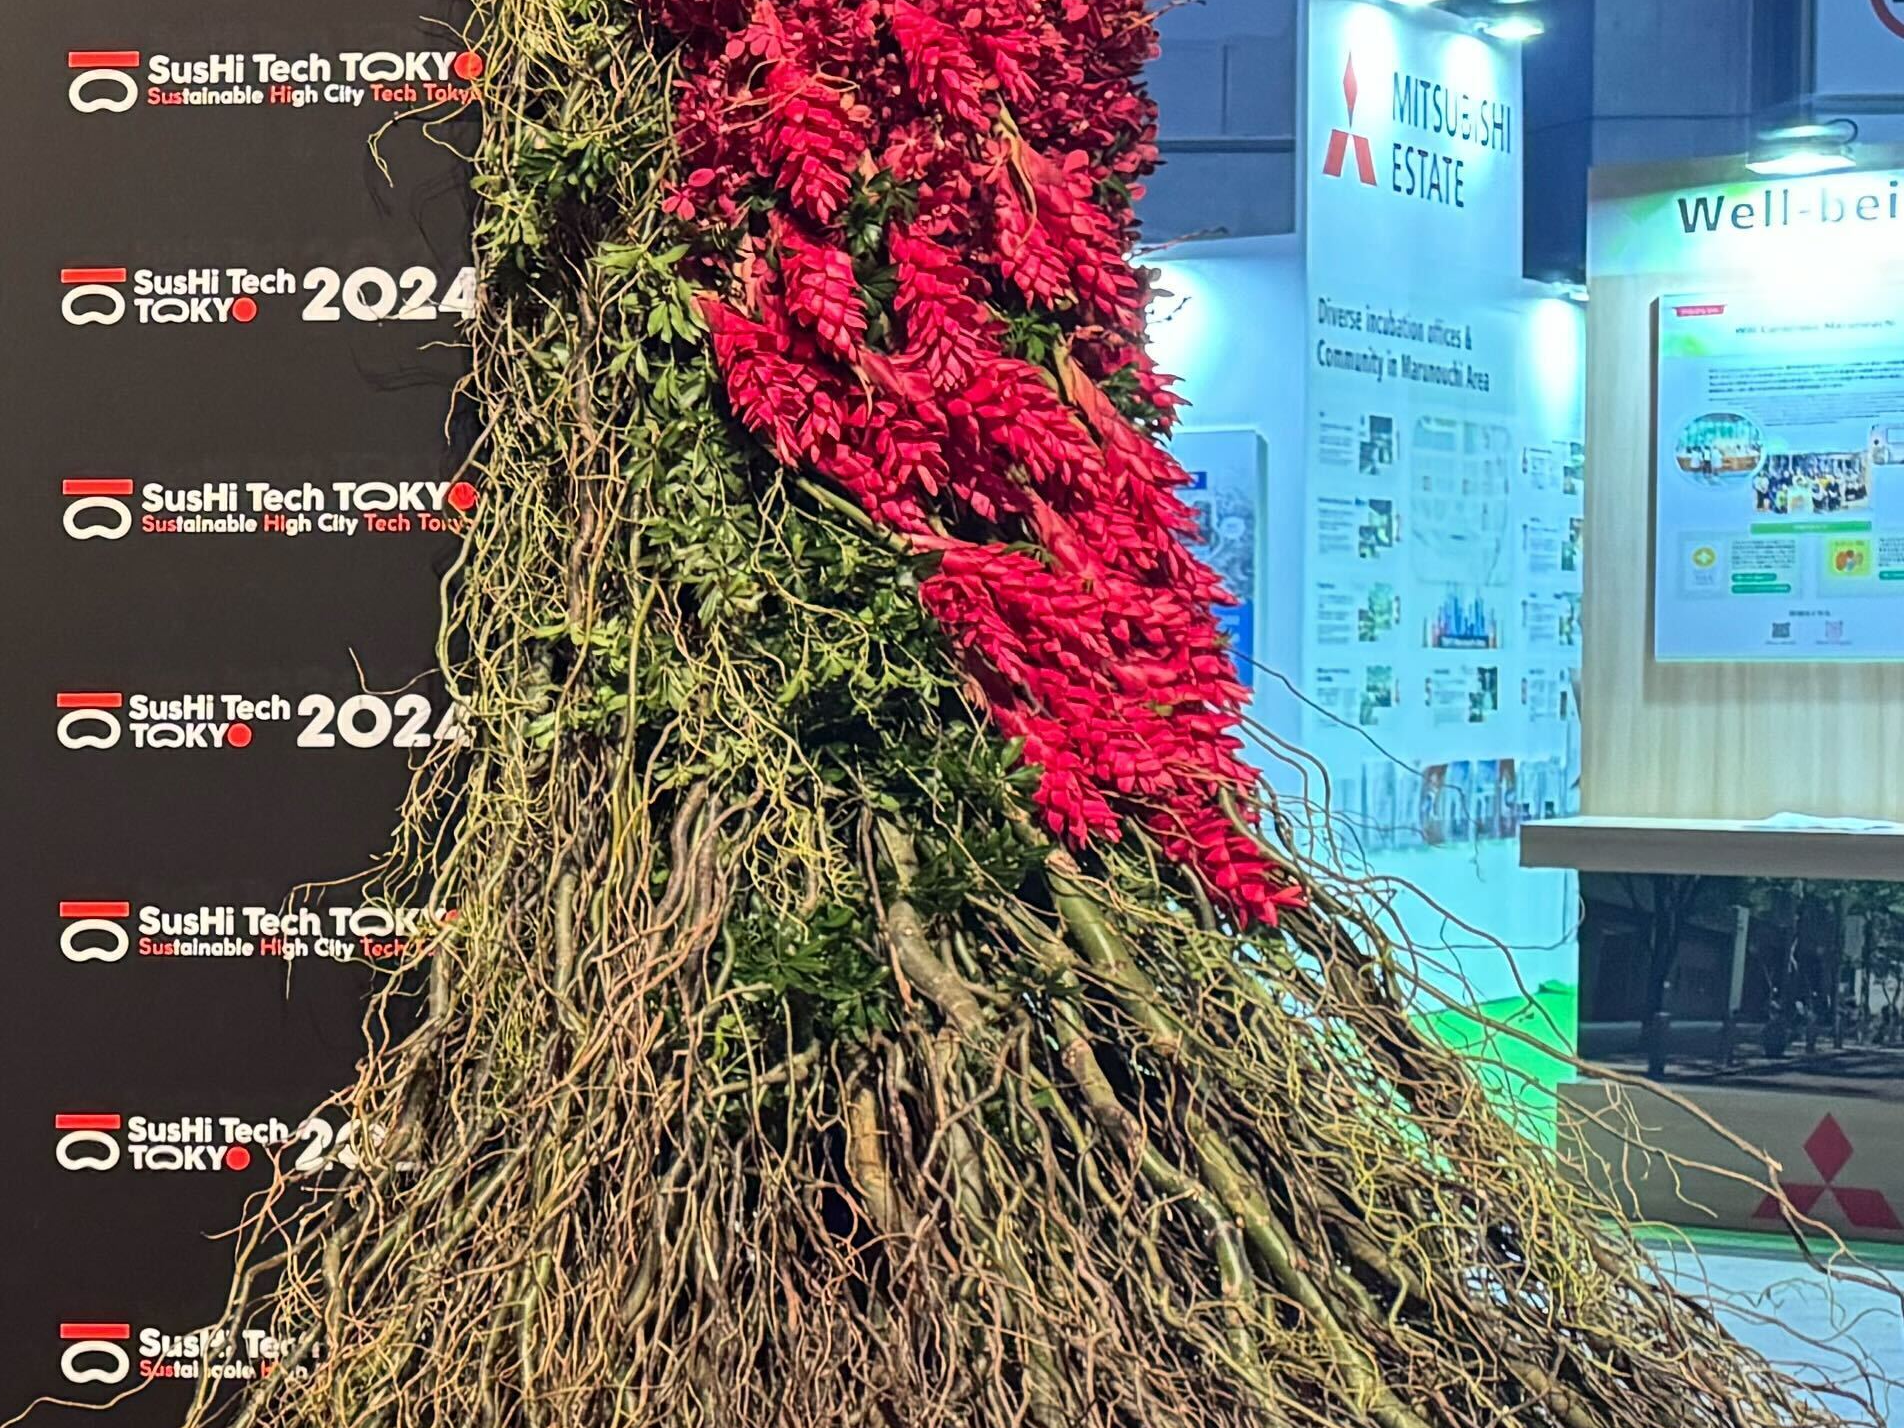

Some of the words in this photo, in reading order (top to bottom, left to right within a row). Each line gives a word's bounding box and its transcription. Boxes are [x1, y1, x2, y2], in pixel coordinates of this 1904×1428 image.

[148, 54, 244, 84] SusHi
[252, 53, 330, 82] Tech
[339, 52, 483, 81] TOKYO
[148, 85, 264, 104] Sustainable
[269, 84, 317, 108] High
[325, 84, 364, 106] City
[370, 84, 416, 101] Tech
[1392, 143, 1464, 208] ESTATE
[1318, 297, 1362, 331] Diverse
[1366, 304, 1424, 342] incubation
[1427, 318, 1461, 349] offices
[1317, 339, 1384, 382] Community
[1386, 349, 1397, 377] in
[1401, 354, 1463, 388] Marunouchi
[1466, 364, 1490, 392] Area
[129, 695, 213, 720] SusHi
[221, 695, 290, 720] Tech
[130, 723, 252, 748] TOKYO
